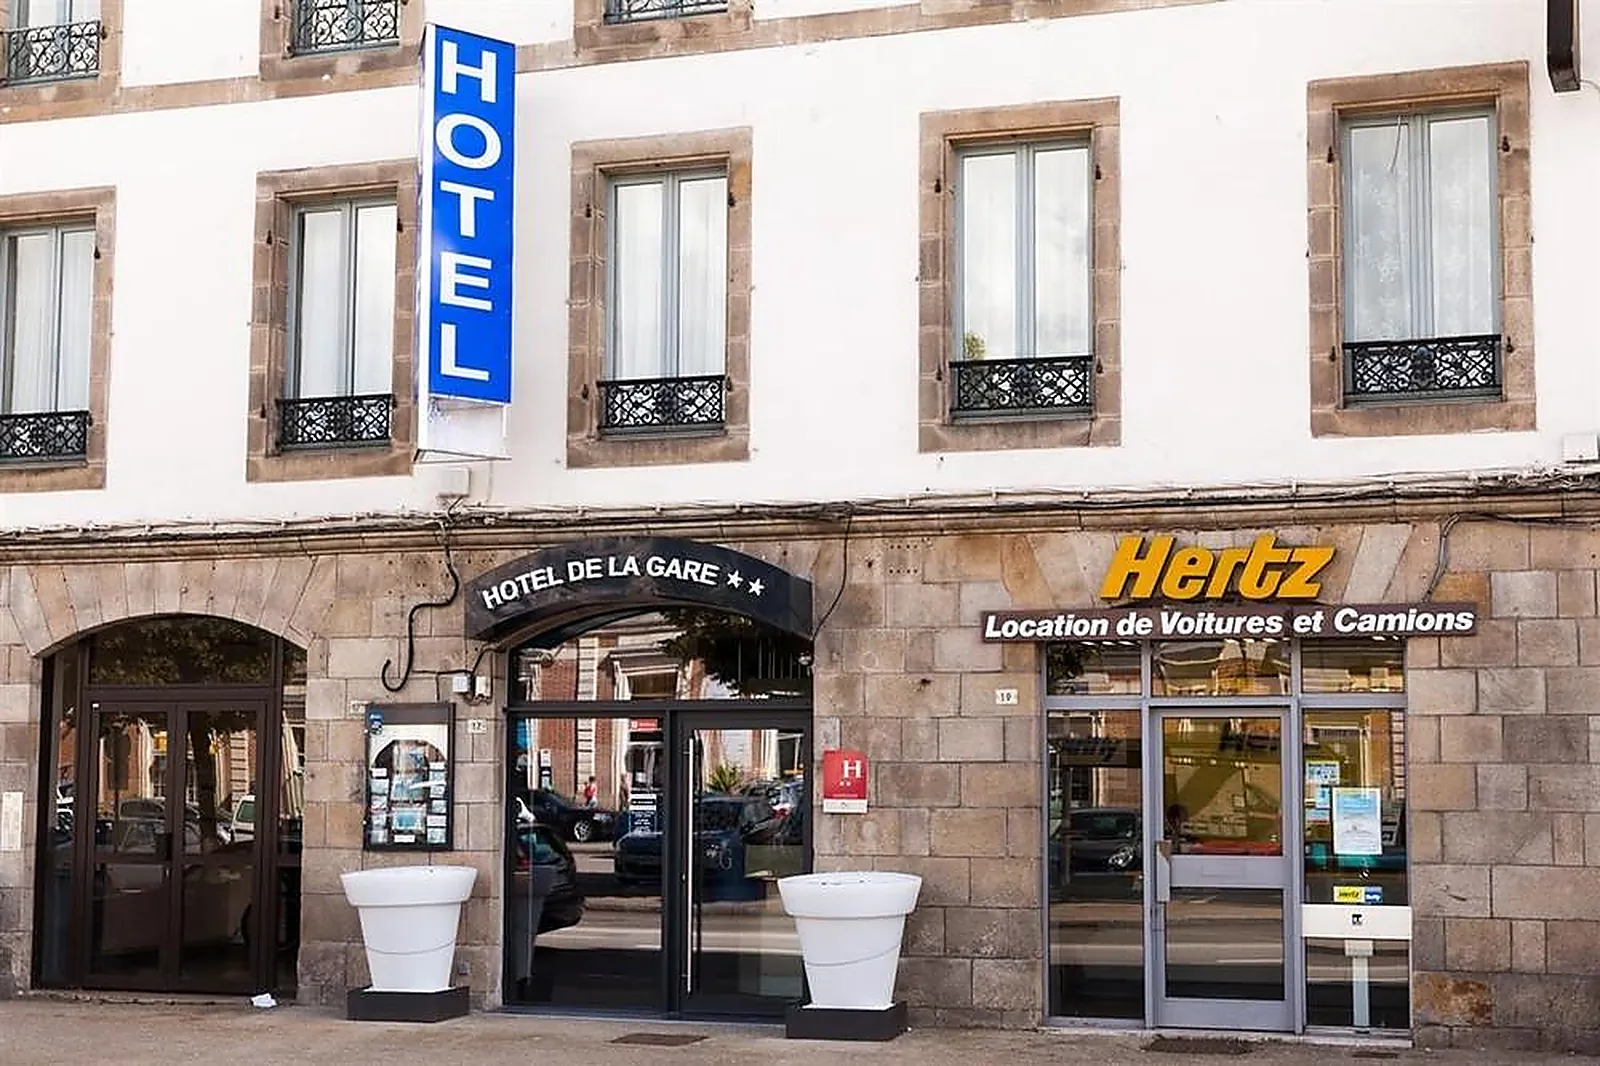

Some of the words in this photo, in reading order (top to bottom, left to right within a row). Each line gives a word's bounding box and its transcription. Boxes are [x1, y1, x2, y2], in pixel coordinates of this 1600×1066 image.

[435, 40, 502, 382] HOTEL
[482, 566, 564, 609] HOTEL
[567, 558, 603, 582] DE
[608, 556, 640, 577] LA
[646, 558, 720, 586] GARE
[1100, 533, 1336, 600] Hertz
[984, 614, 1108, 639] Location
[1116, 612, 1153, 635] de
[1160, 610, 1284, 636] Voitures
[1293, 610, 1324, 633] et
[1334, 608, 1475, 633] Camions
[843, 759, 862, 779] H
